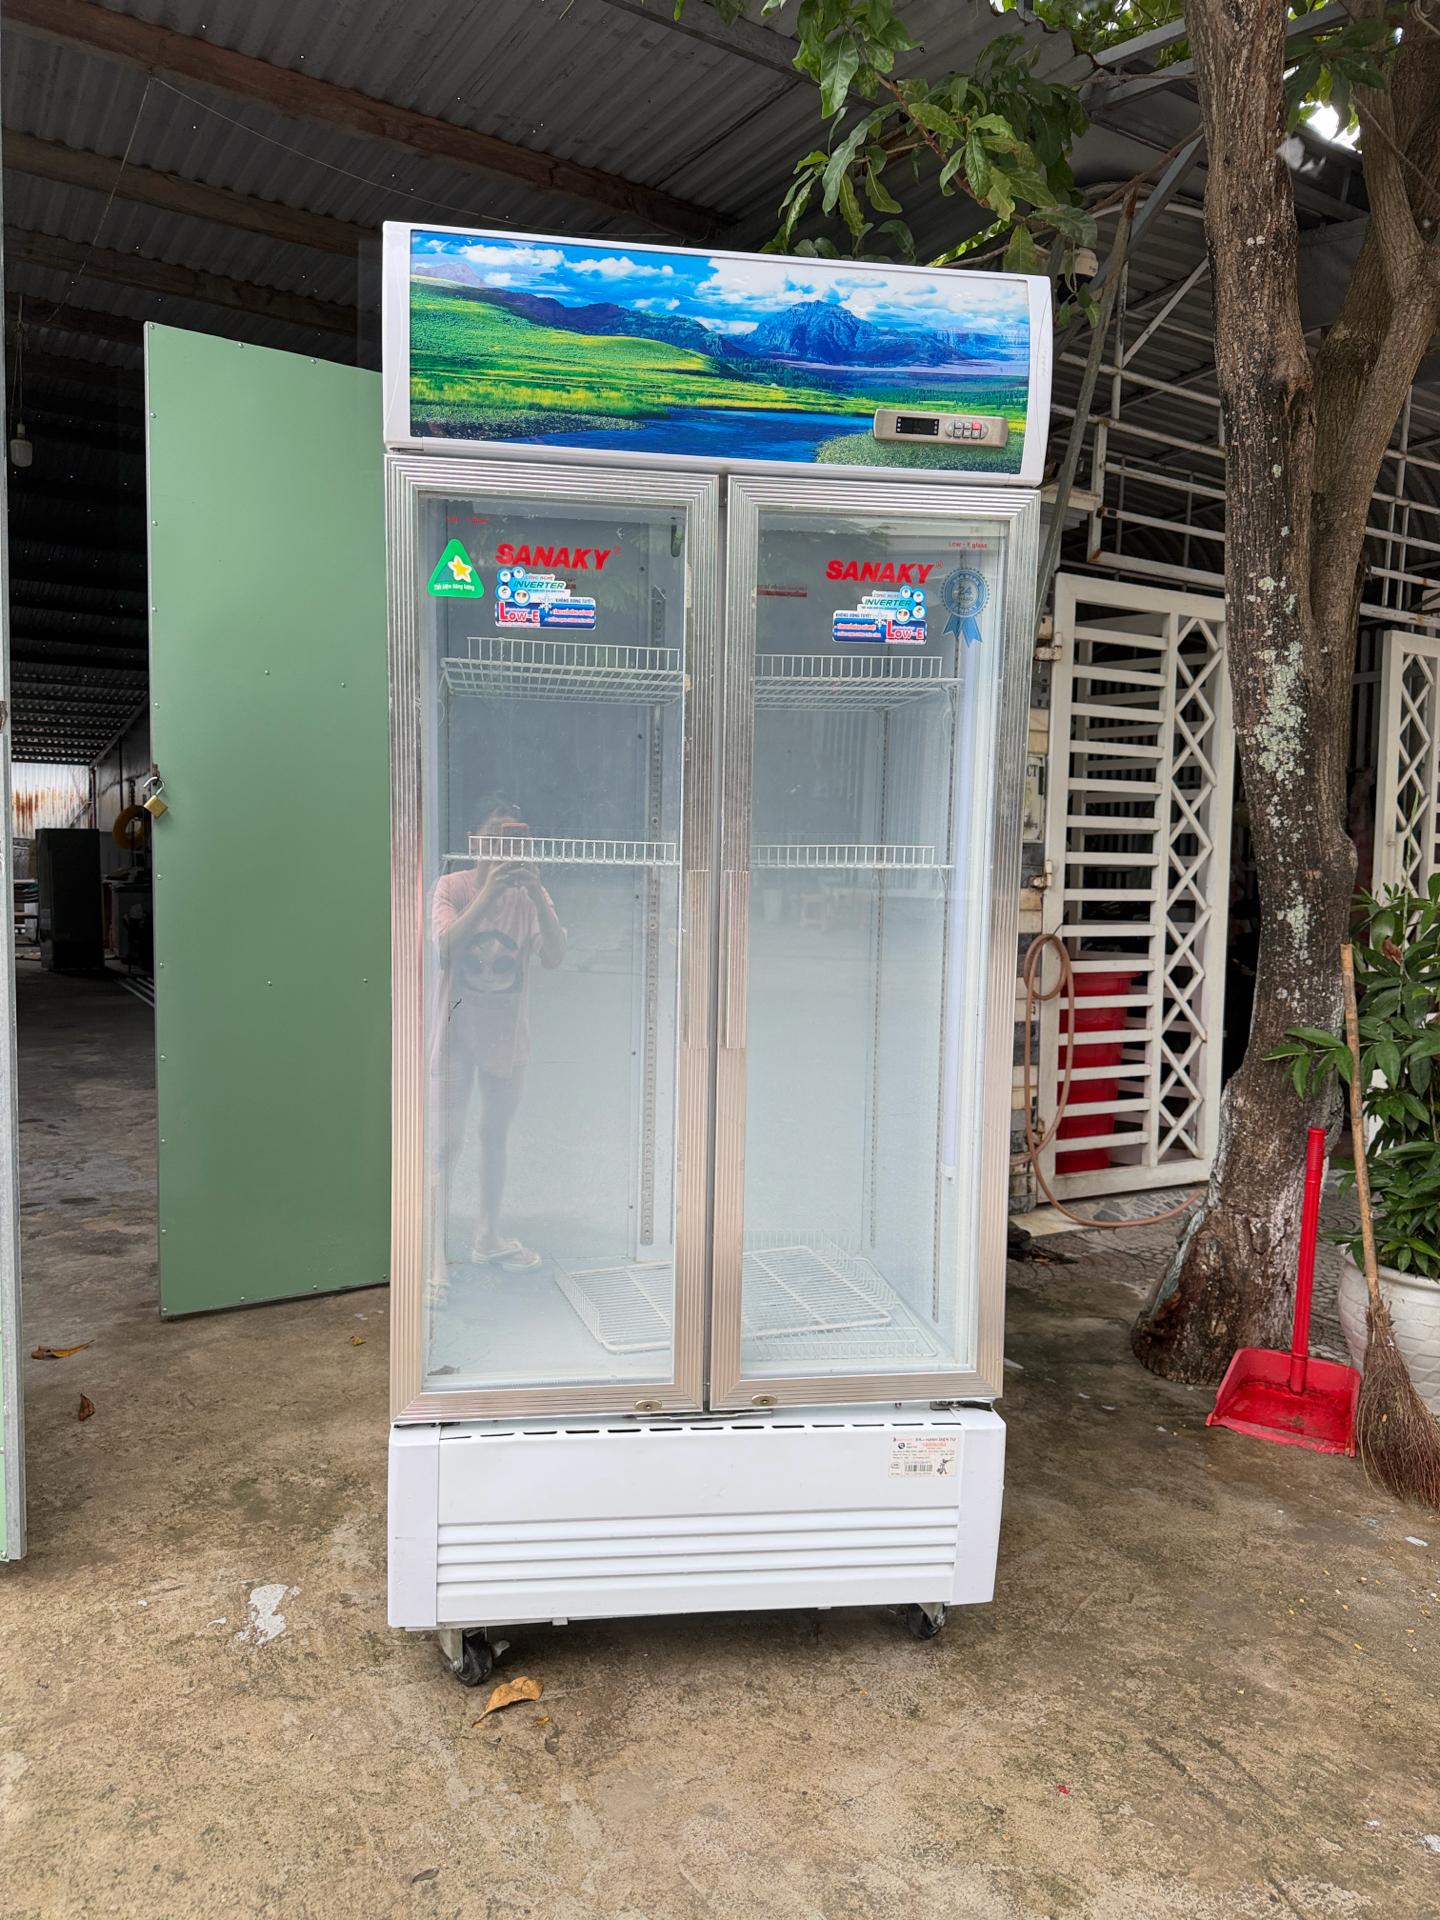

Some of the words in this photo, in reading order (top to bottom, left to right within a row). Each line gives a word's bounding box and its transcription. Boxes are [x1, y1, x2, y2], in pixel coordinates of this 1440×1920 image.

[496, 543, 612, 570] SANAKY
[825, 560, 935, 584] SANAKY
[514, 580, 565, 590] INVERTER
[864, 598, 913, 607] INVERTER
